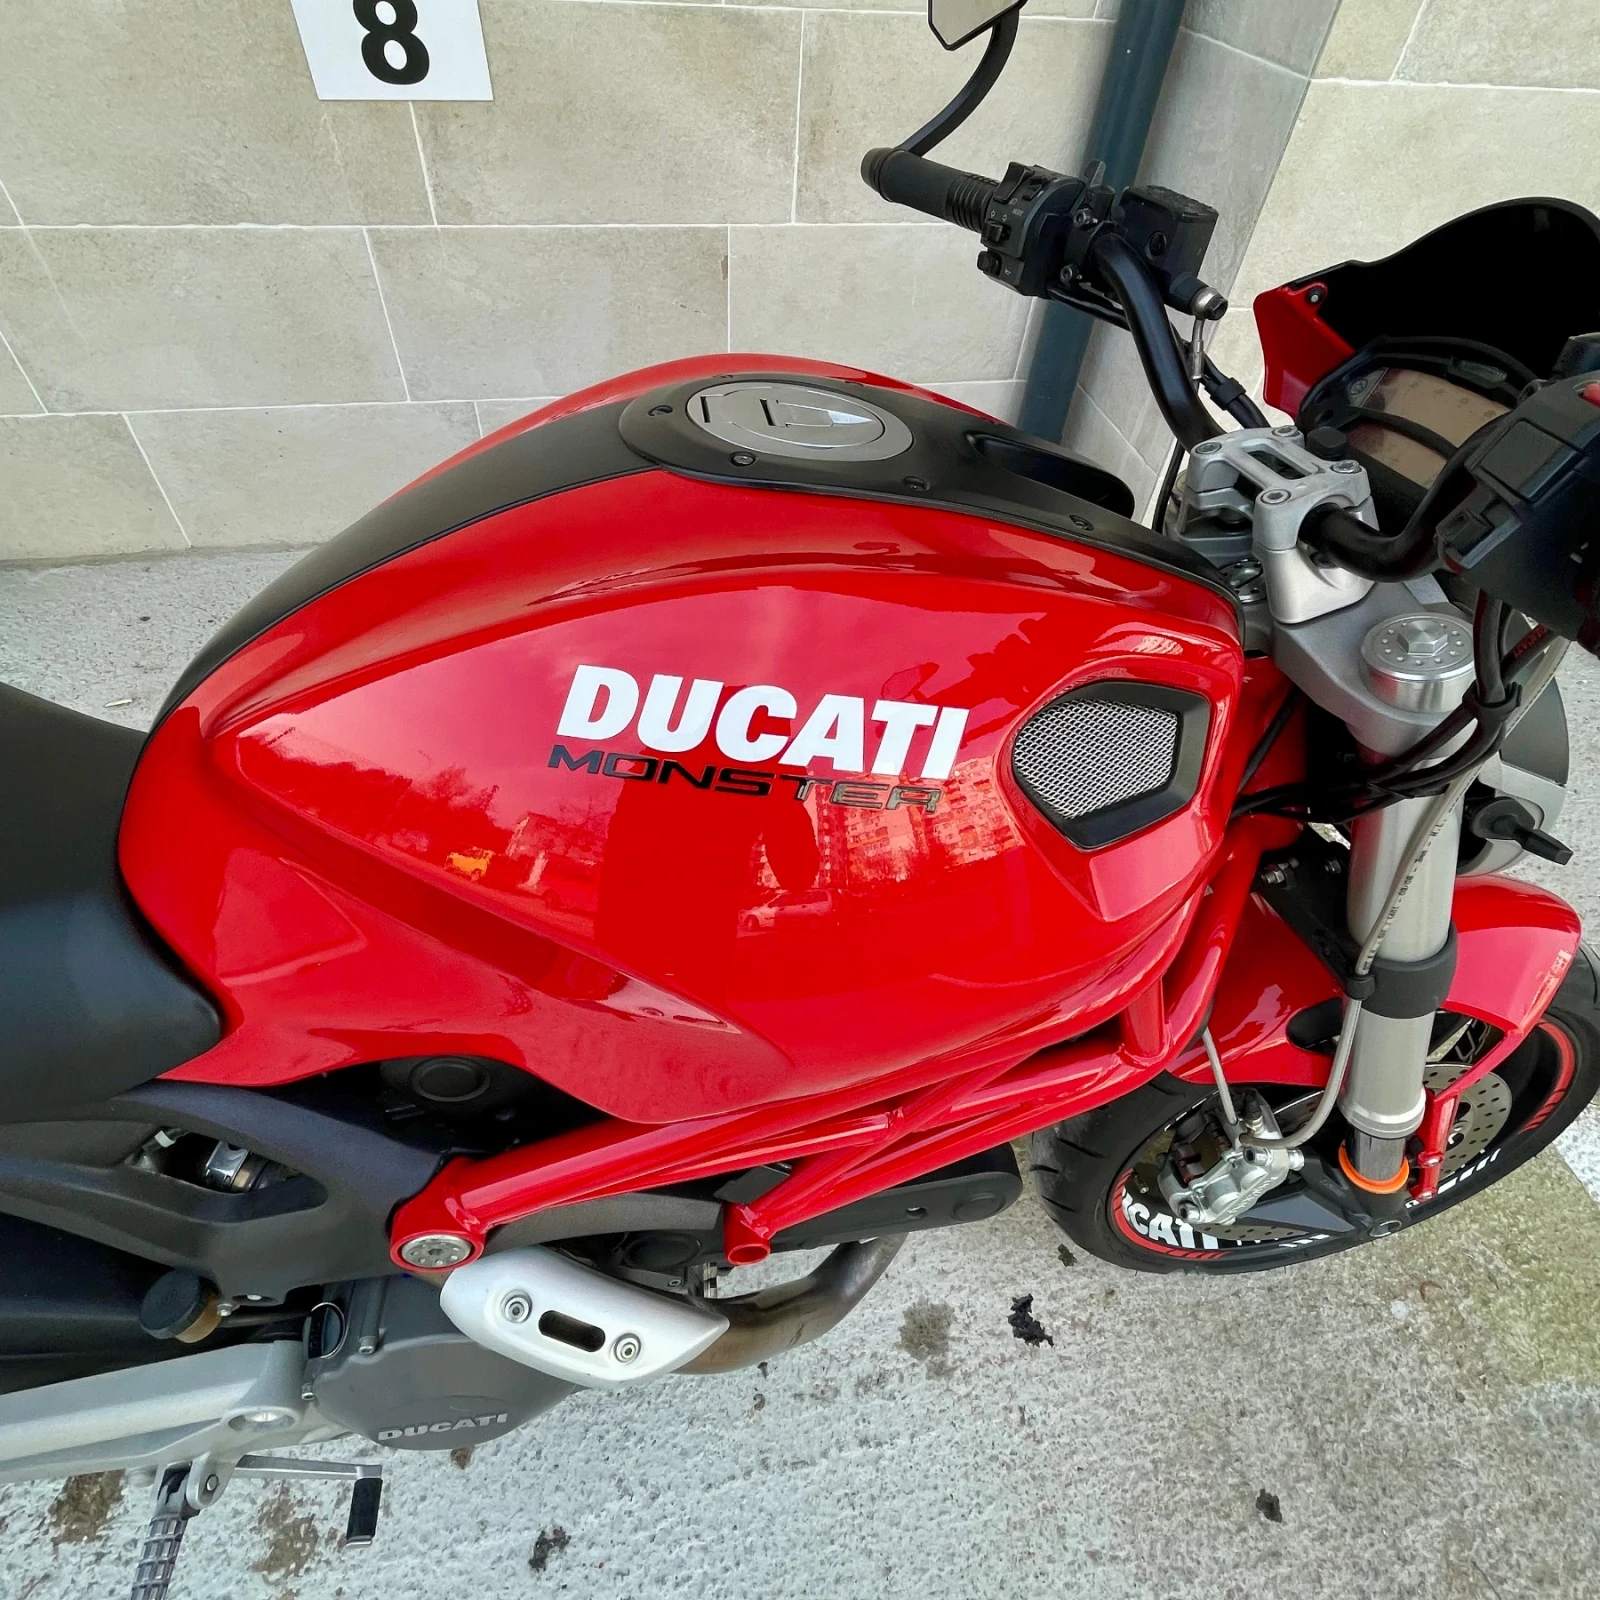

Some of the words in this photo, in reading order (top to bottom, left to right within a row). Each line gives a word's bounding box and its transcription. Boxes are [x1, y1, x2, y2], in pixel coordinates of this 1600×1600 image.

[352, 0, 430, 85] 8
[556, 664, 970, 780] DUCATI
[547, 744, 945, 814] MONSTER
[378, 1412, 508, 1441] DUCATI
